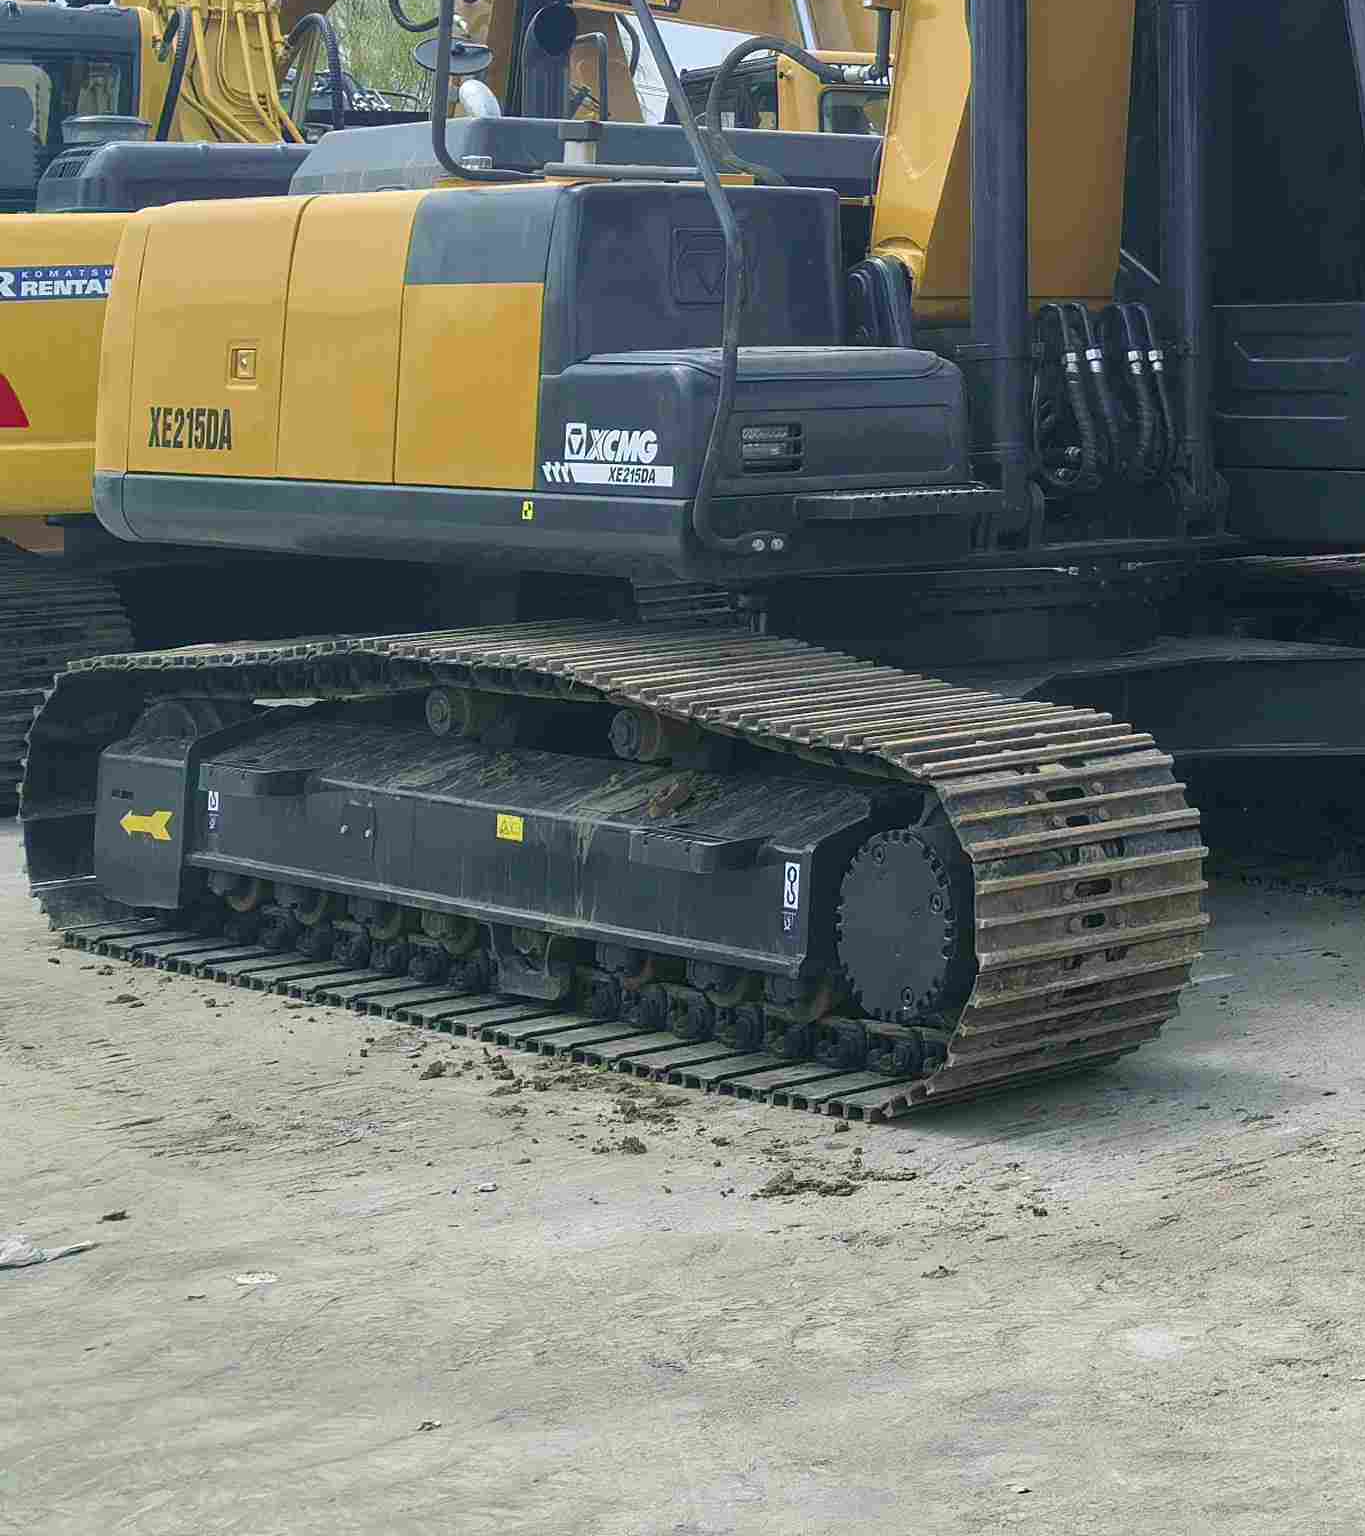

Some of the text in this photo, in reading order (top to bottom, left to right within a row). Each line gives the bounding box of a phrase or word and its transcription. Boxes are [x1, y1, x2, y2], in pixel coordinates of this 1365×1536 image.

[21, 268, 113, 279] KOMATSU
[147, 407, 233, 451] XE215DA
[586, 428, 659, 464] XCMG
[607, 466, 657, 485] XE215DA
